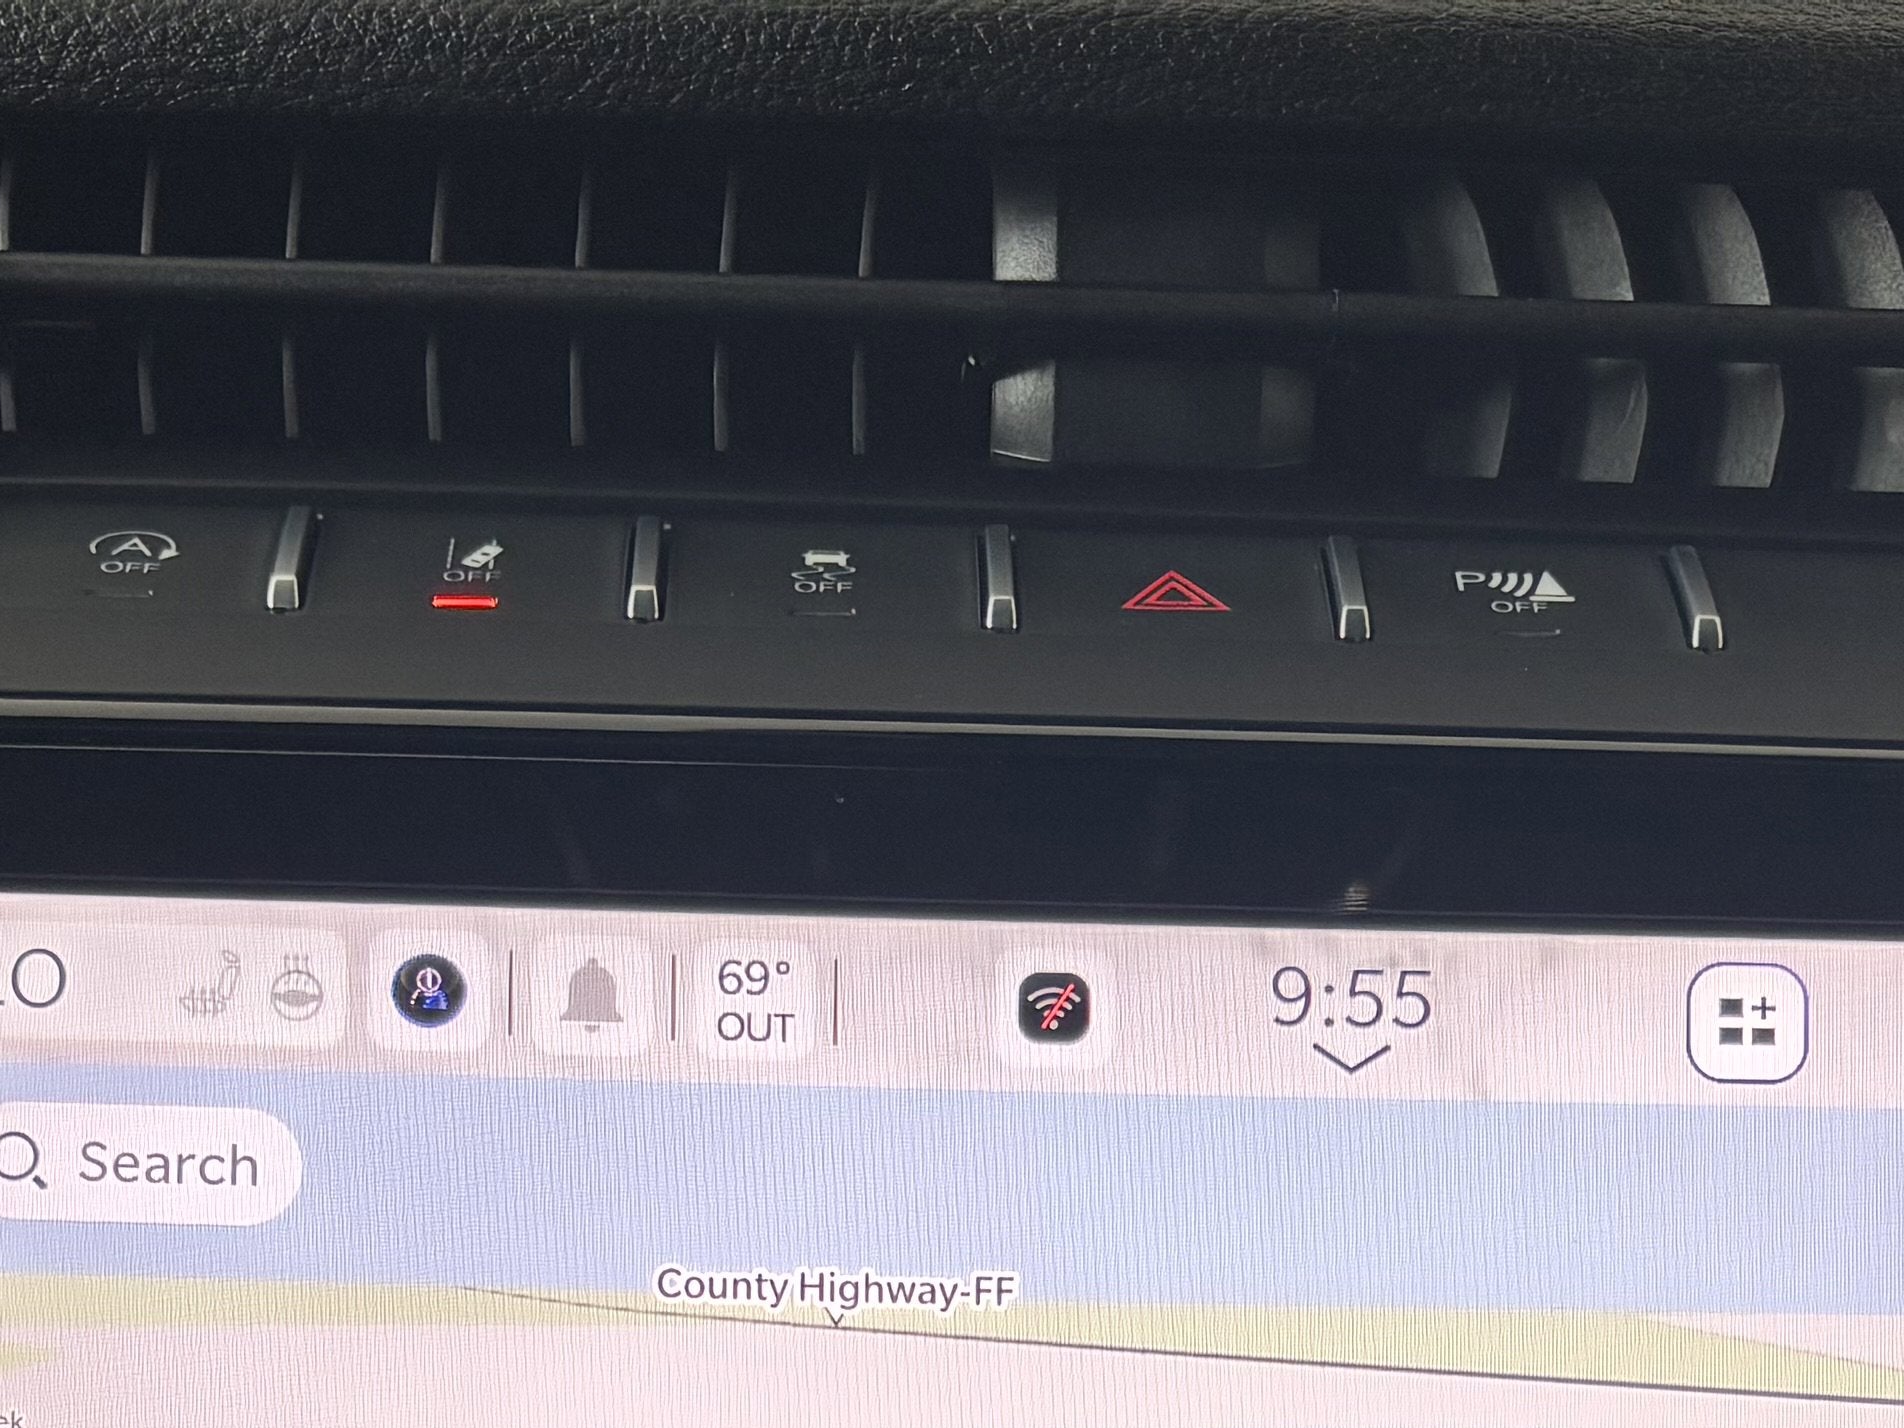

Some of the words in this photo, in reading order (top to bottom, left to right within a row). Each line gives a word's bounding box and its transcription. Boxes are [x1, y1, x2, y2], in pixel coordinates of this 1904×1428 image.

[99, 560, 161, 575] OFF
[442, 567, 503, 583] OFF
[792, 579, 854, 594] OFF
[1490, 599, 1549, 615] OFF
[1270, 964, 1434, 1031] 9:55
[715, 1010, 797, 1045] OUT
[77, 1139, 261, 1189] Search
[655, 1266, 789, 1310] County
[799, 1270, 1016, 1312] Highway-FF
